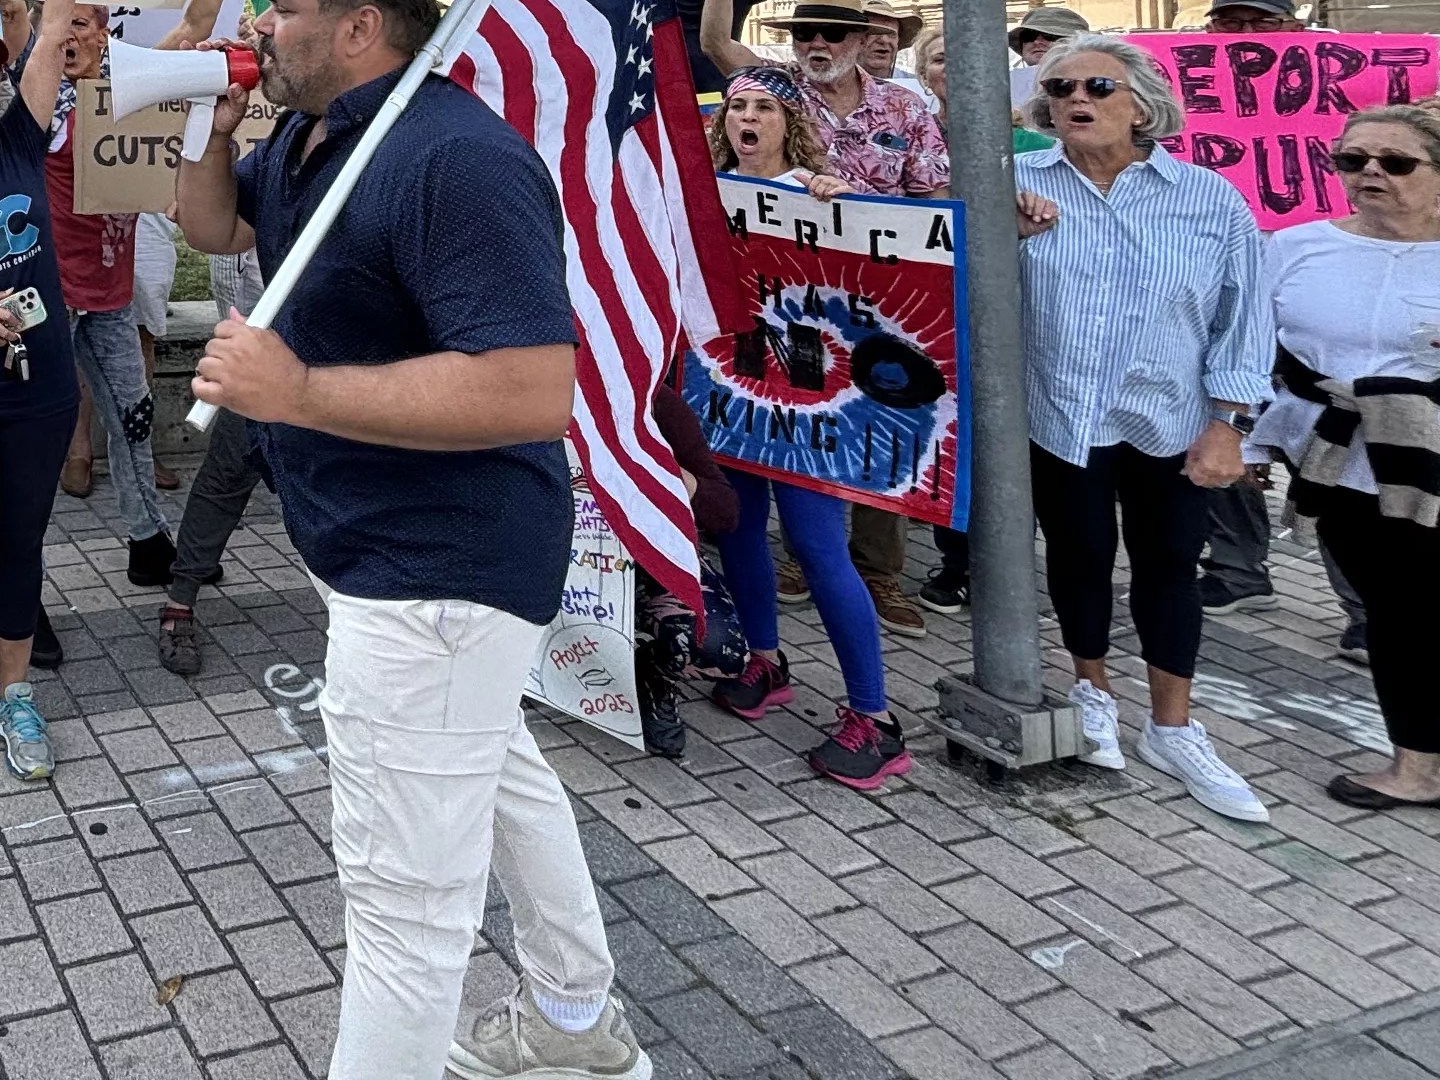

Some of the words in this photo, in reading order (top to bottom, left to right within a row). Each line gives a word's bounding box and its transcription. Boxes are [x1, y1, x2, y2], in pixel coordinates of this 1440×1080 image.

[1154, 41, 1431, 118] EPORT
[93, 134, 184, 169] CUTS
[758, 273, 875, 328] HAS
[733, 314, 947, 409] NO
[549, 635, 600, 671] Project
[580, 693, 634, 716] 2025
